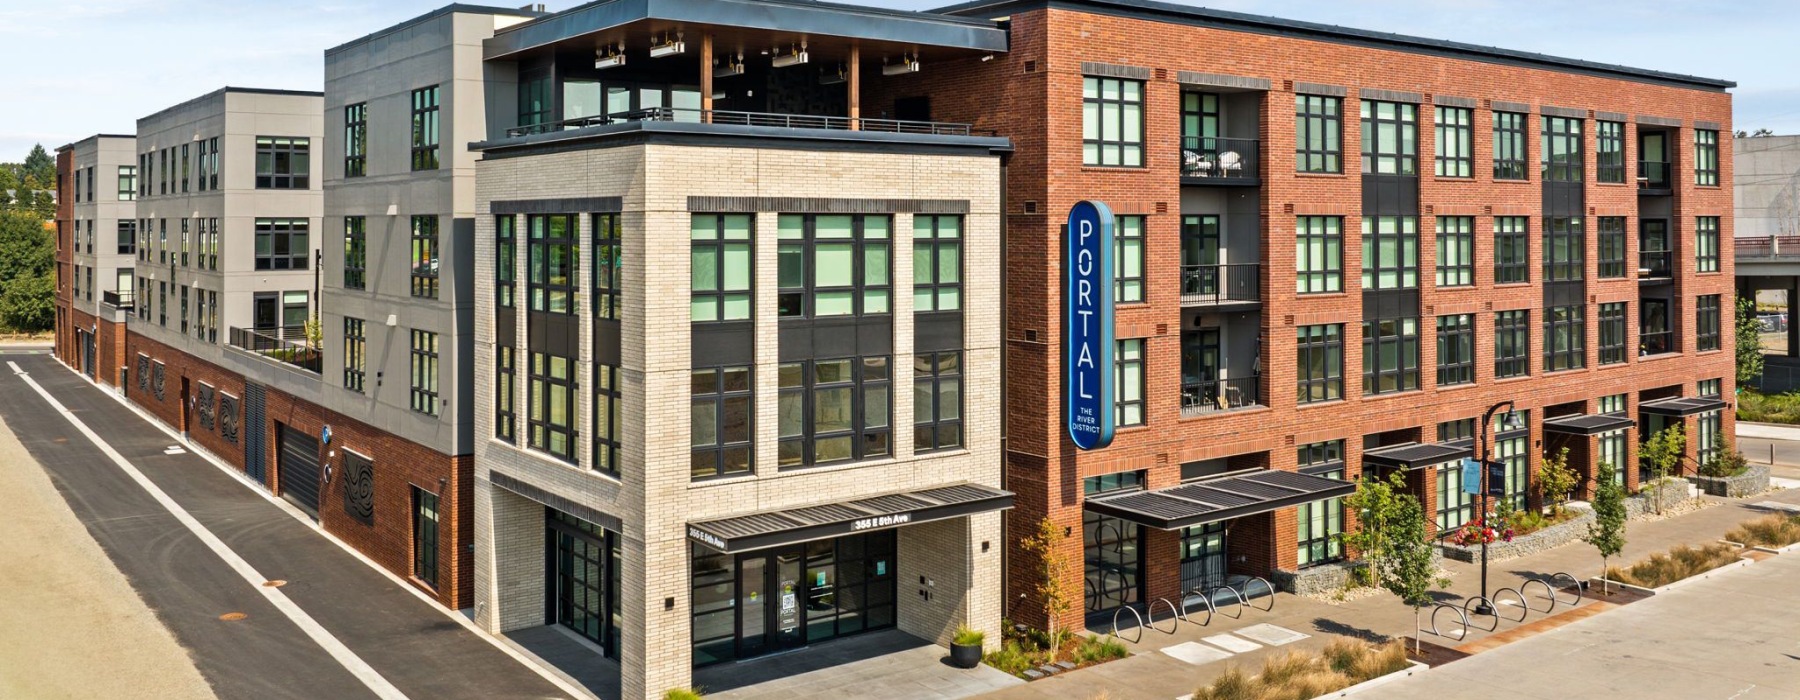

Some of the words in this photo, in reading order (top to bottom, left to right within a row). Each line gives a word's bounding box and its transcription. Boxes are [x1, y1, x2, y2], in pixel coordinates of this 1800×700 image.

[1078, 219, 1094, 399] PORTAL
[1080, 406, 1093, 416] THE
[1077, 415, 1096, 425] RIVER
[1072, 423, 1101, 434] DISTRICT
[855, 518, 871, 530] 355
[872, 517, 878, 527] E
[878, 515, 893, 526] 5th
[893, 514, 908, 524] Ave
[690, 528, 700, 538] 355
[700, 532, 704, 540] E
